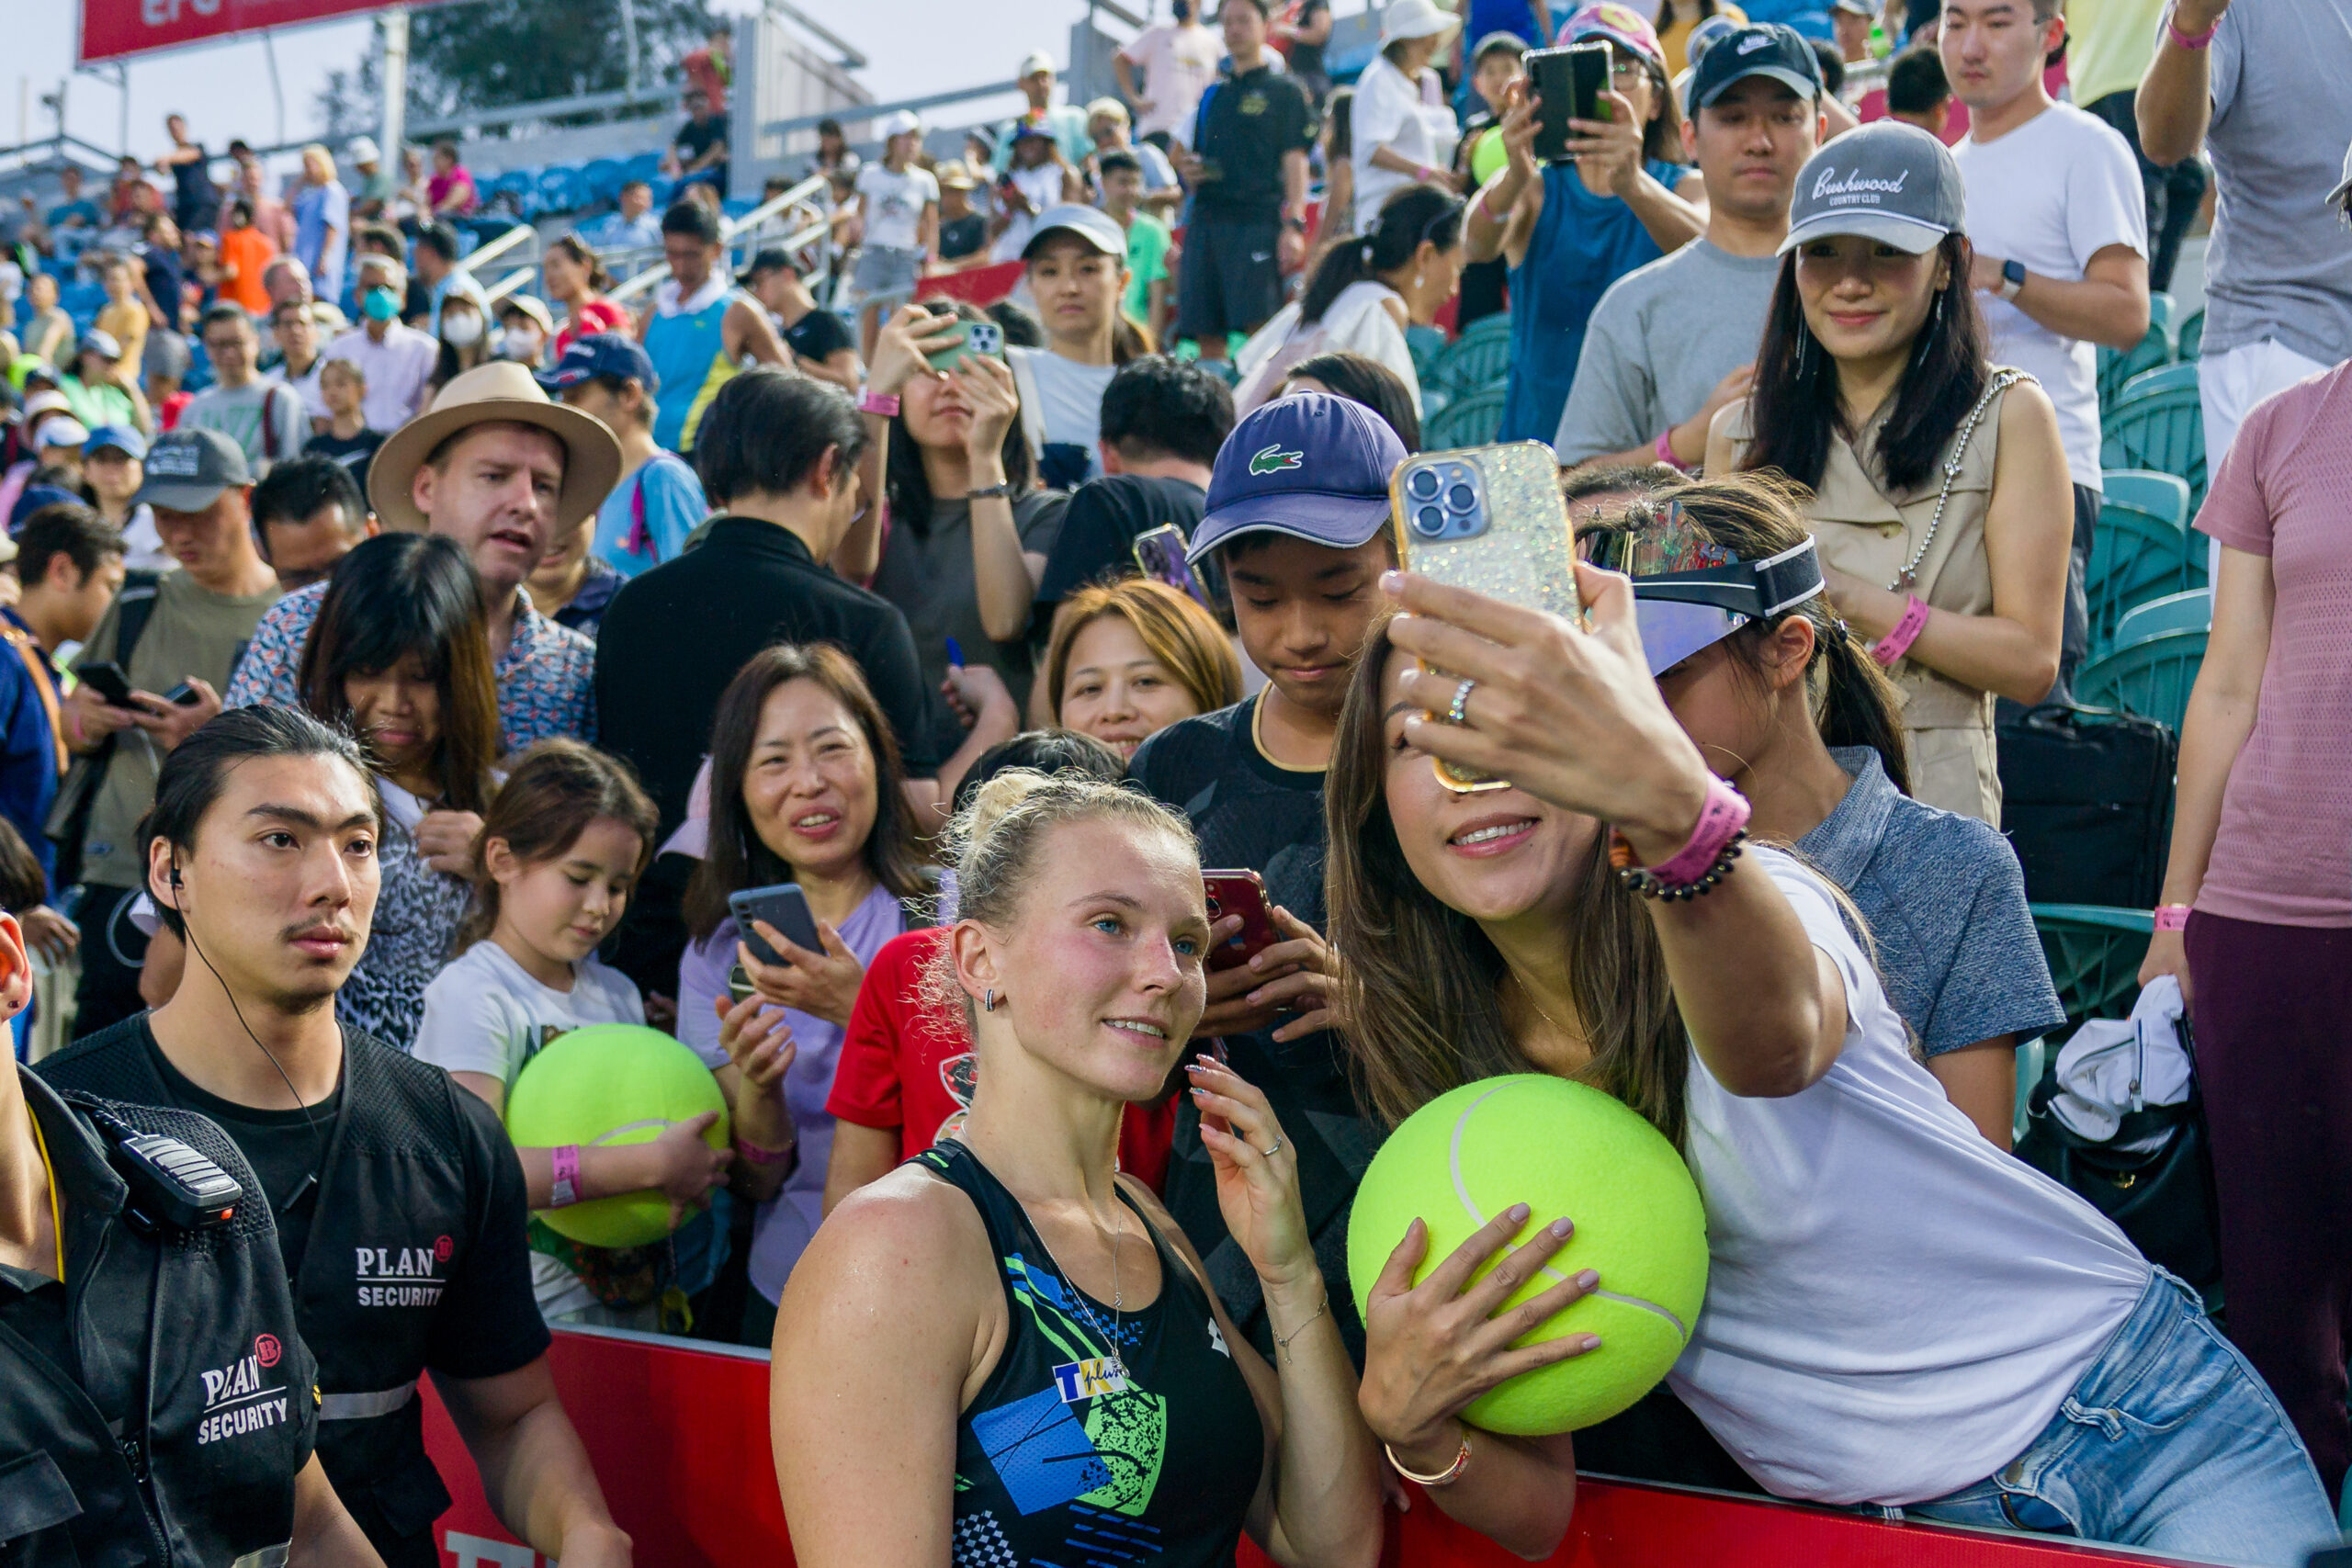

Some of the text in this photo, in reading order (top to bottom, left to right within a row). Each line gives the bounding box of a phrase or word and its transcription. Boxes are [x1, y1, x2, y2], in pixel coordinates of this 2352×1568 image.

[1812, 166, 1909, 200] Bushwood
[1828, 193, 1881, 207] COUNTRY CLUB
[356, 1247, 435, 1277] PLAN
[357, 1286, 443, 1307] SECURITY
[200, 1354, 260, 1406] PLAN
[198, 1397, 288, 1445] SECURITY
